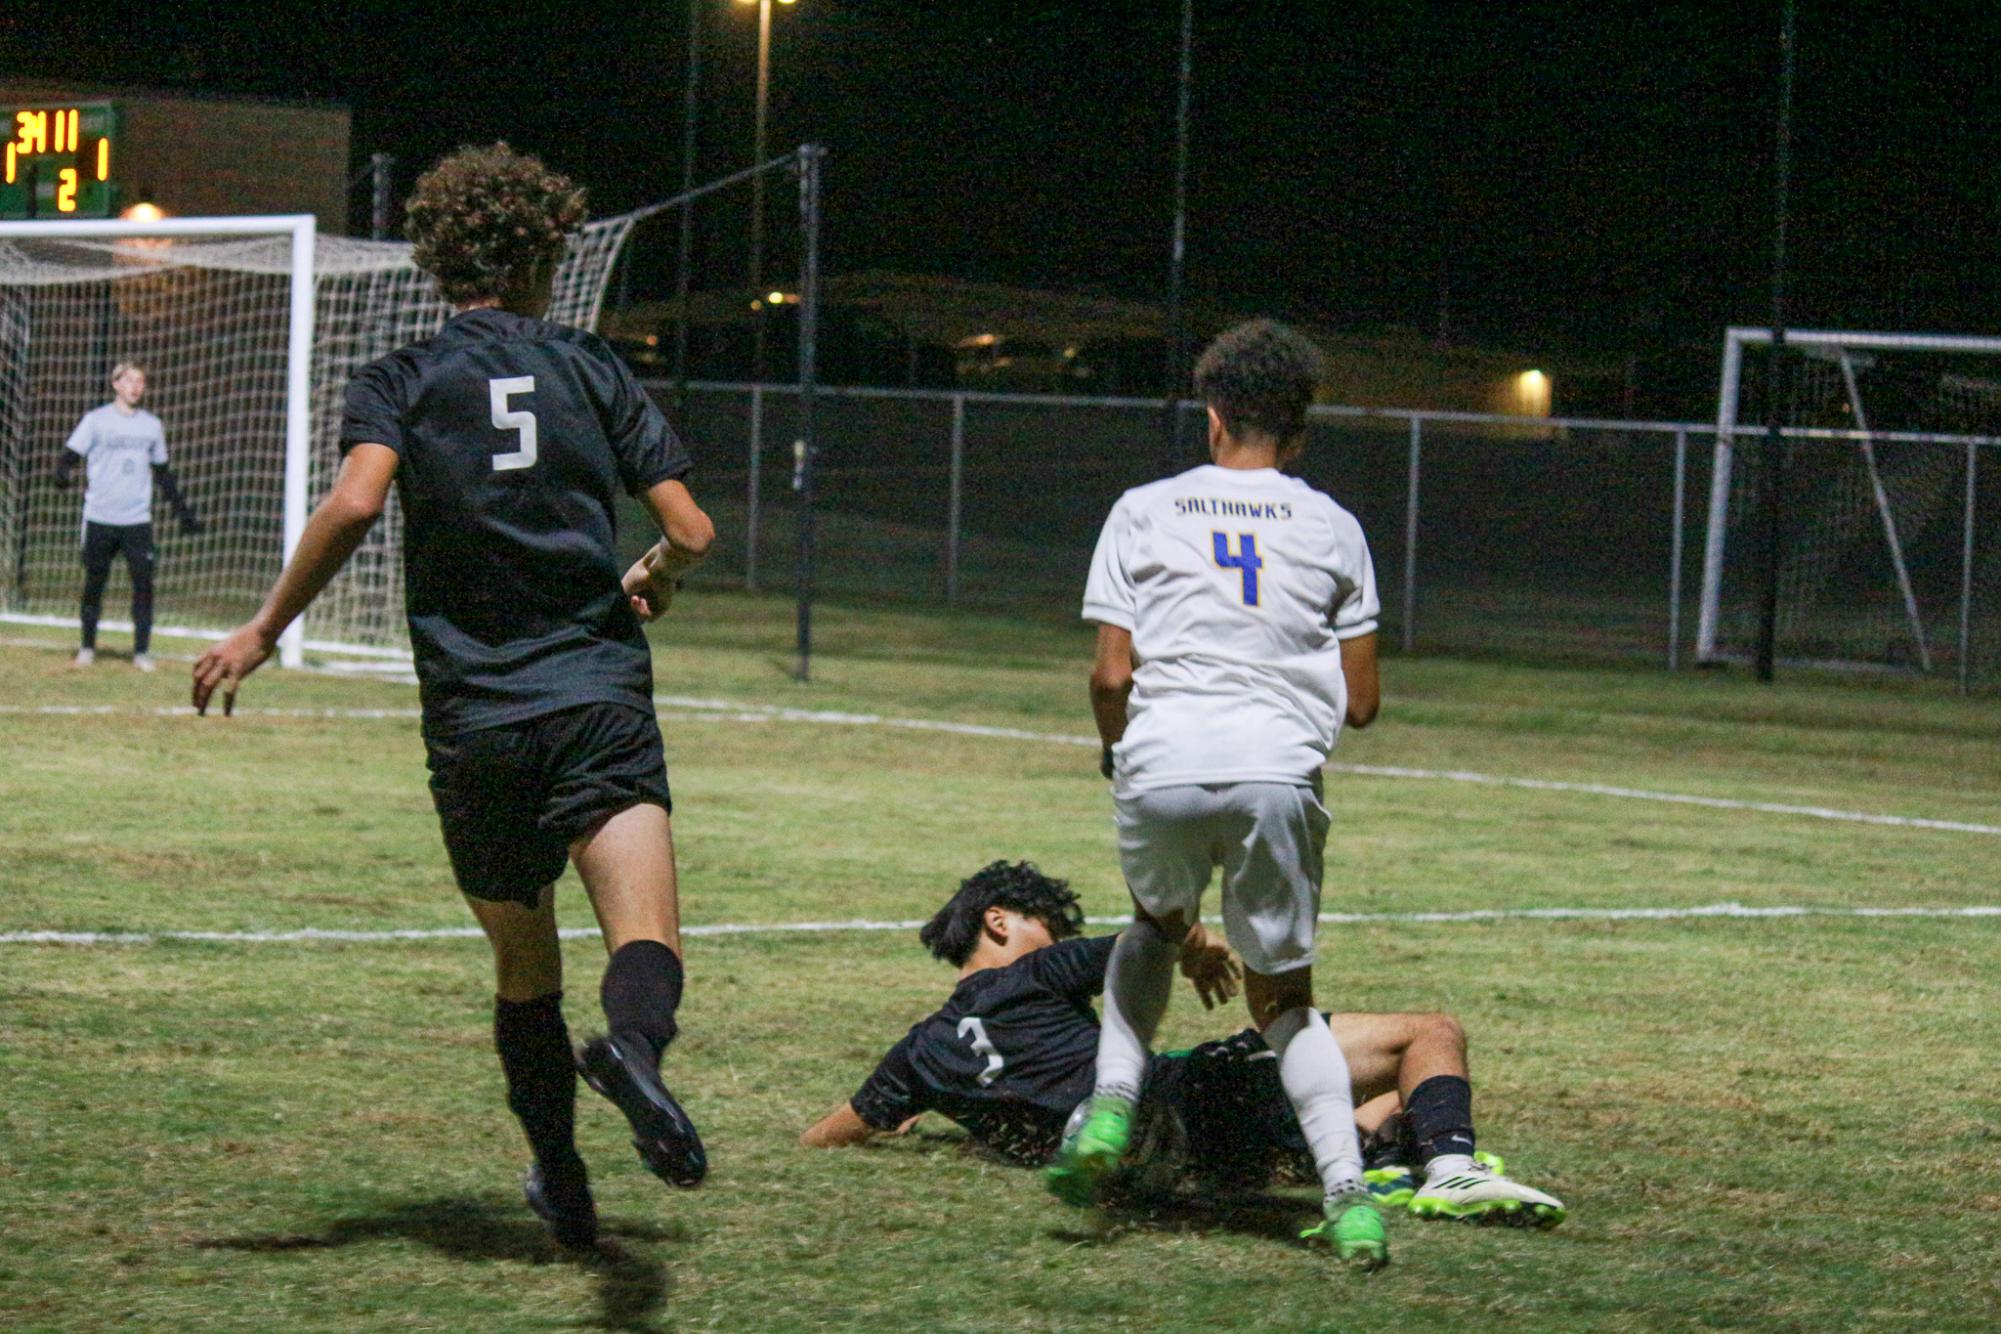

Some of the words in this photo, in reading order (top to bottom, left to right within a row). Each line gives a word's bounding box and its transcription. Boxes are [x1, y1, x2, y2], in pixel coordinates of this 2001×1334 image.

[97, 138, 109, 181] 1
[58, 168, 77, 212] 2
[489, 375, 537, 471] 5
[1174, 497, 1293, 520] SALTHAWKS
[1210, 528, 1264, 608] 4
[957, 1016, 1004, 1087] 3
